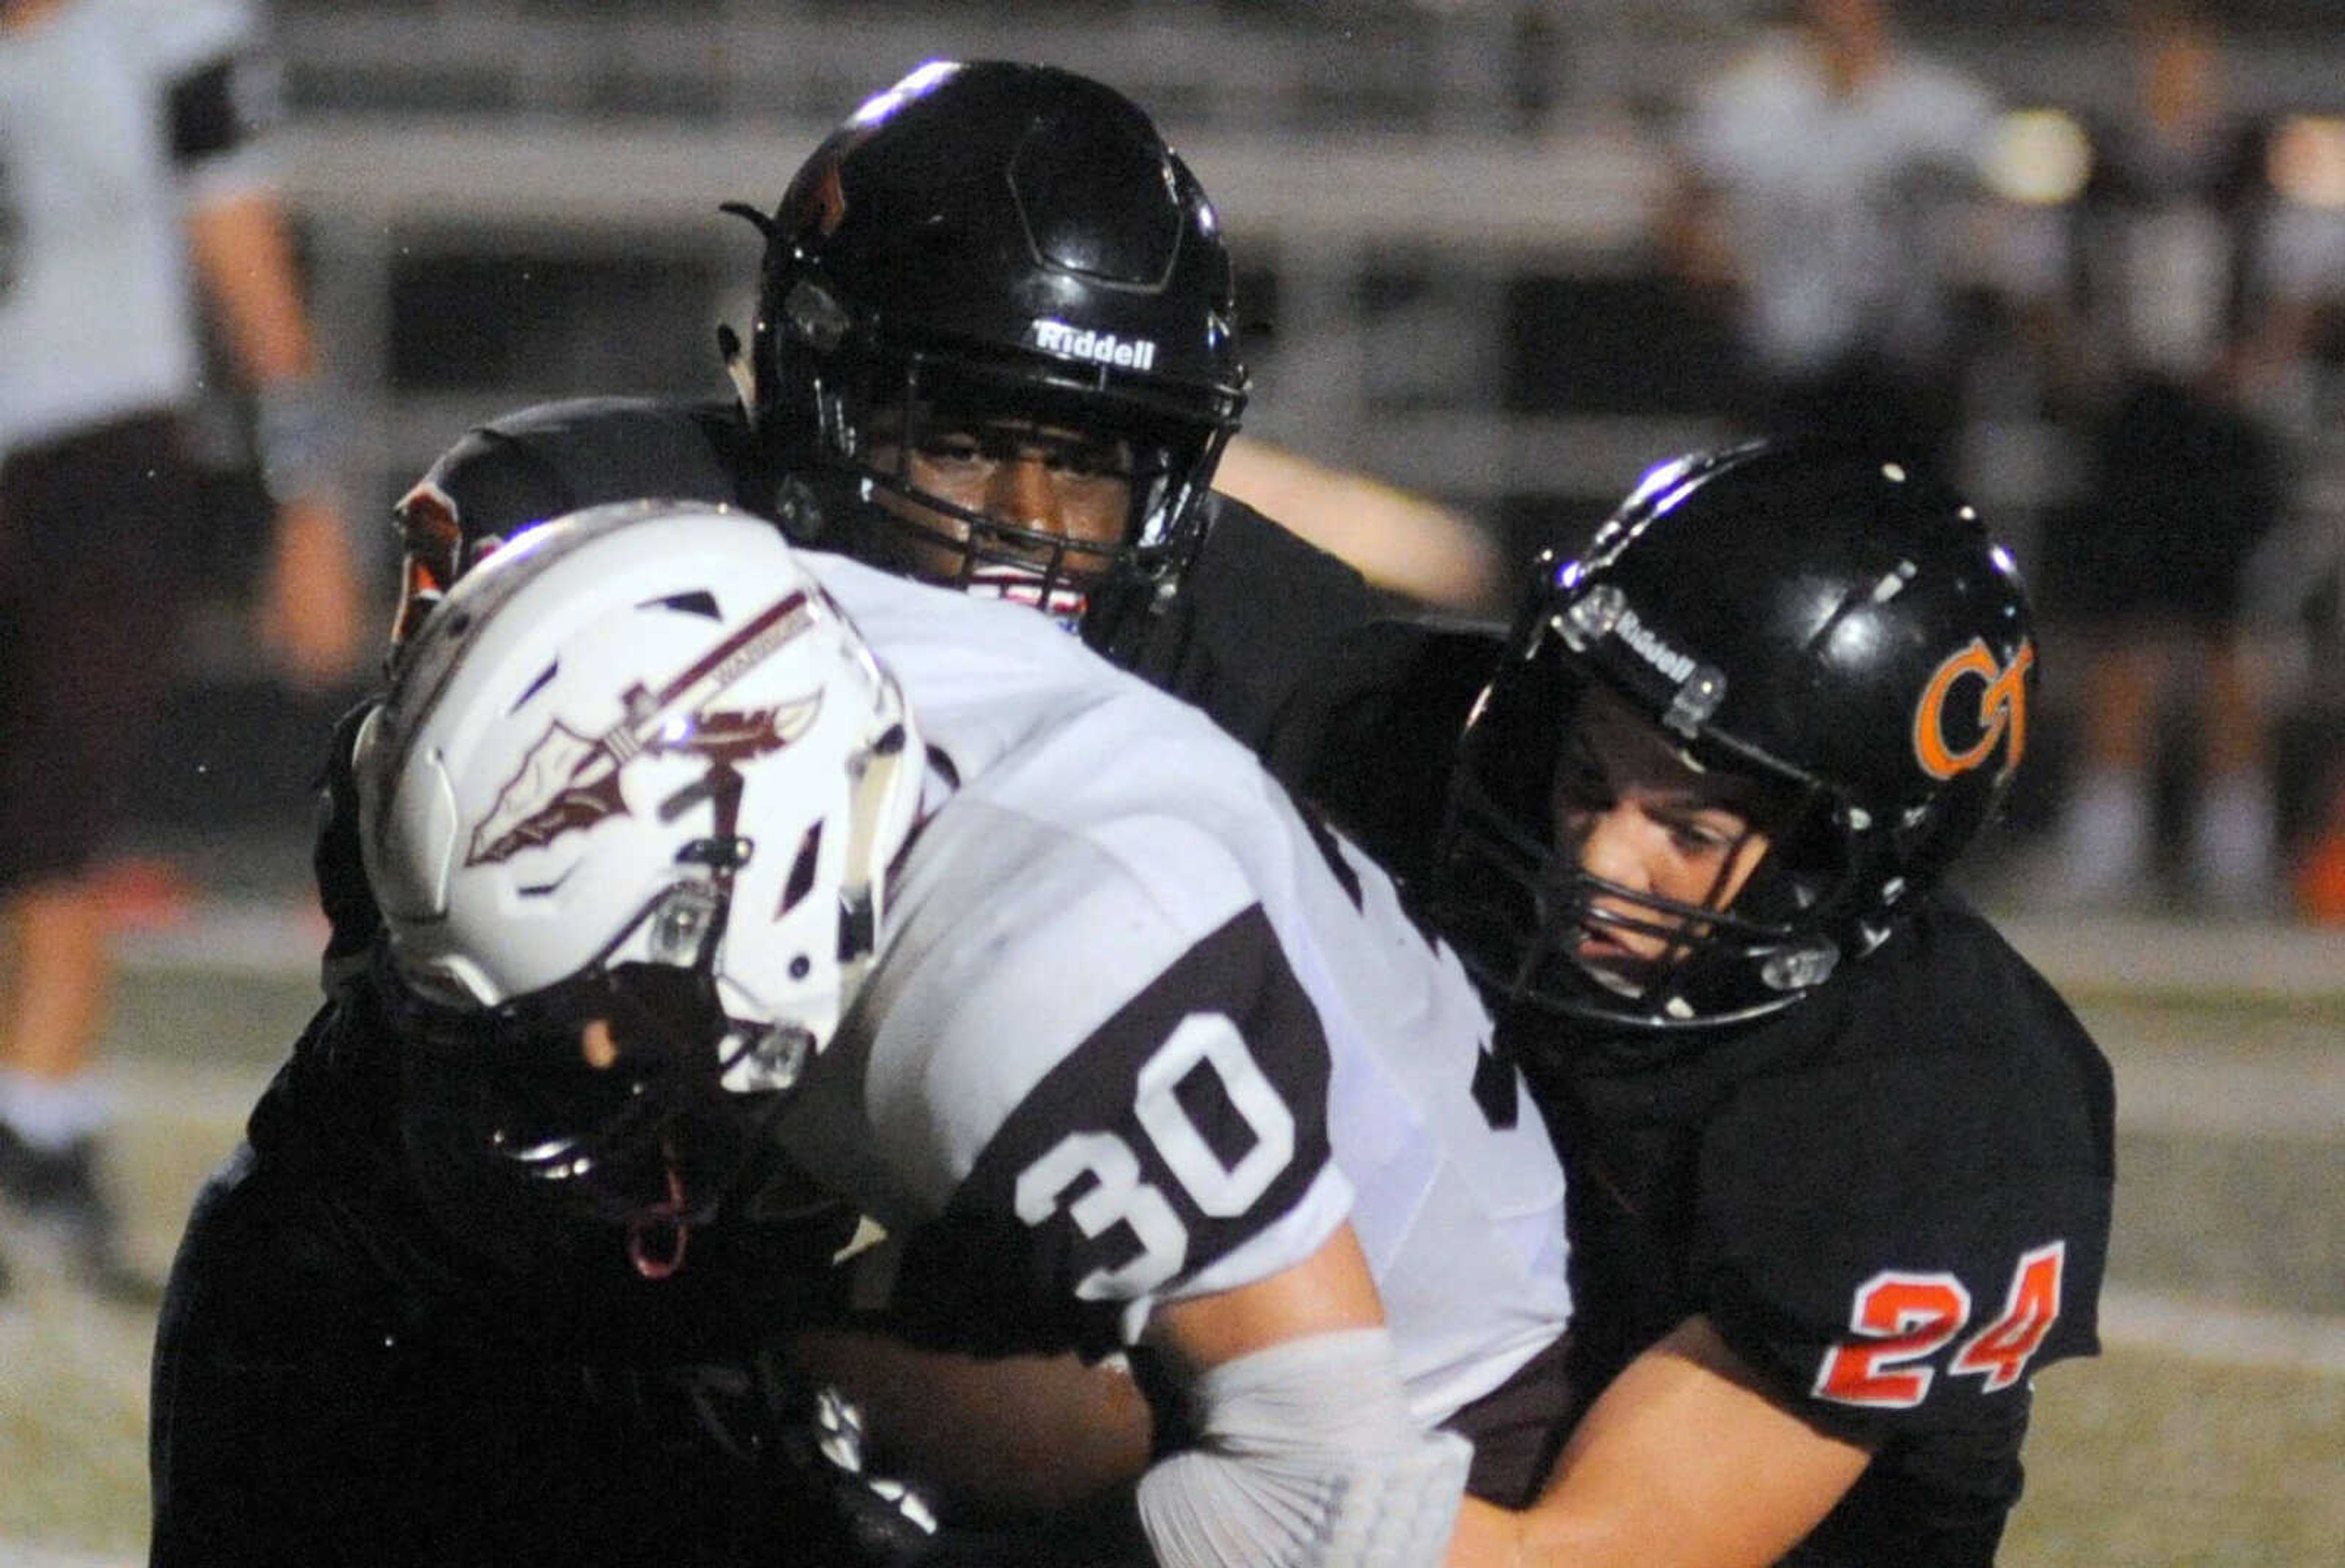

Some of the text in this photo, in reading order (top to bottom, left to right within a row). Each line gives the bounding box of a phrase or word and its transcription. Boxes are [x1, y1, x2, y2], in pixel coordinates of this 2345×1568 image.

[1032, 319, 1155, 371] Riddell
[1615, 609, 1696, 684] Riddell
[1015, 1012, 1295, 1301] 30
[1811, 1240, 2065, 1409] 24
